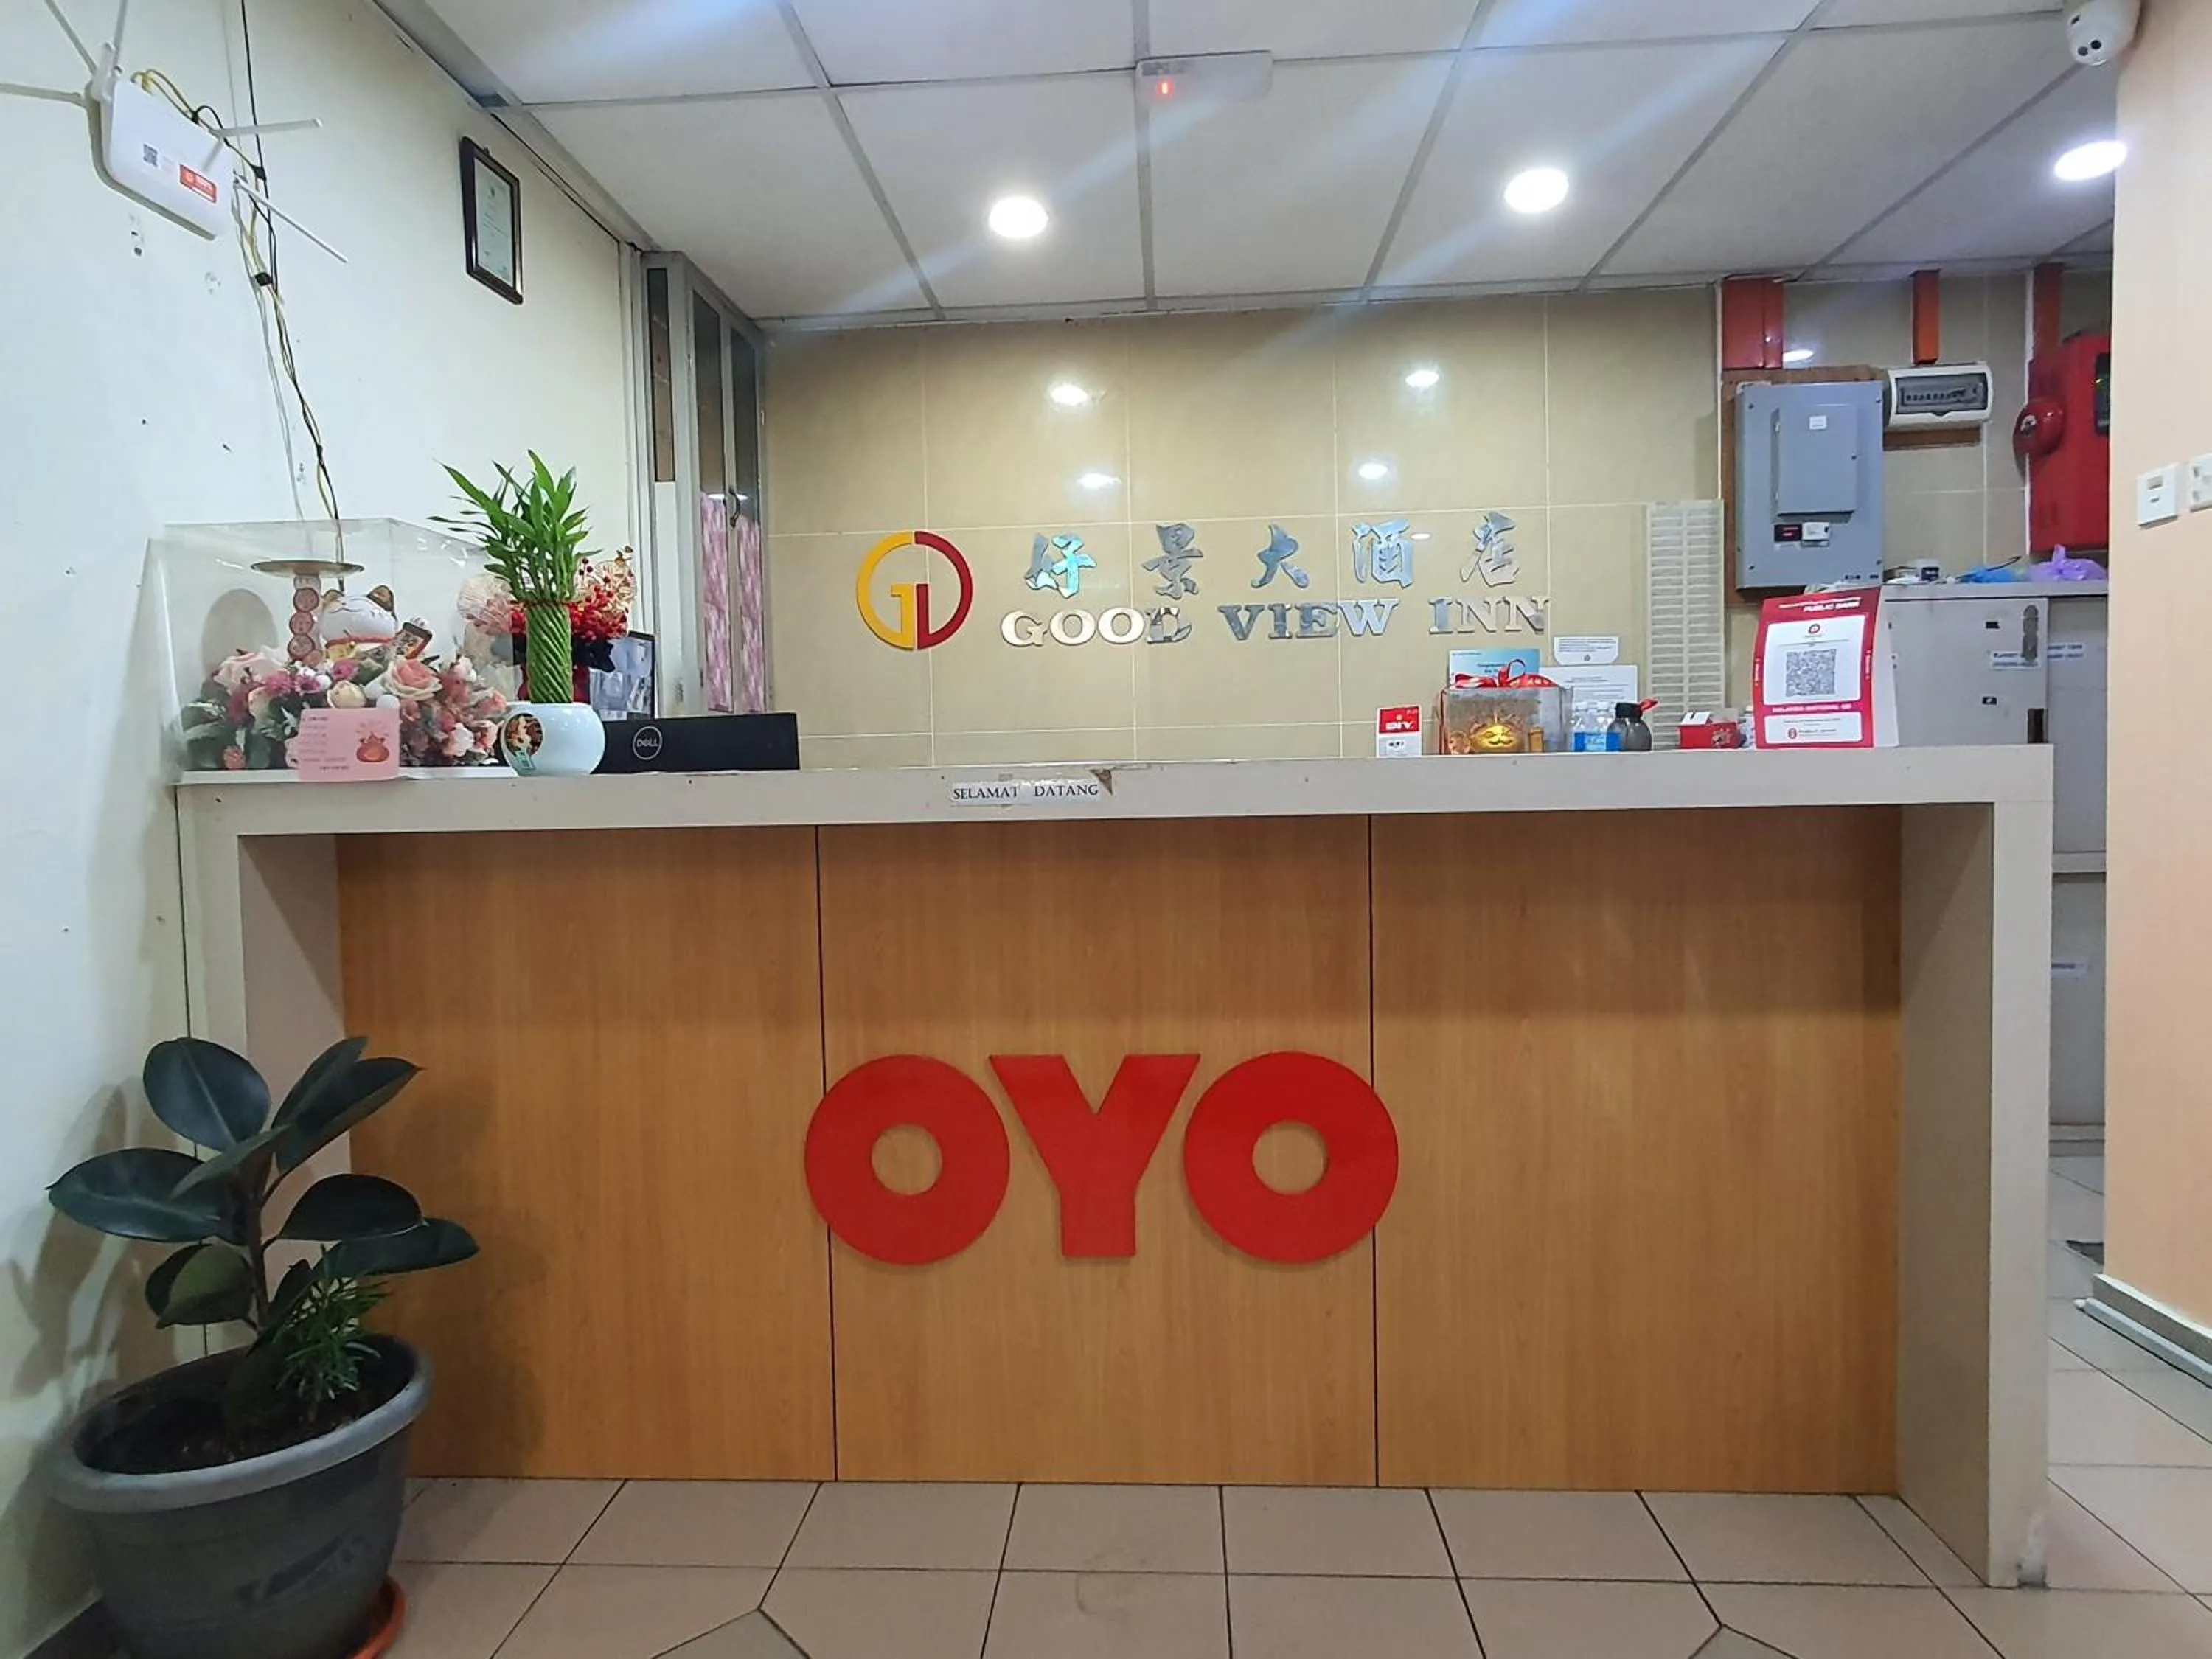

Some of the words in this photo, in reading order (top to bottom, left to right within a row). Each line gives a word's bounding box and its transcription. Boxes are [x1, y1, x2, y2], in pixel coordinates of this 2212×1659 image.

[1001, 606, 1193, 647] GOOD
[1217, 598, 1400, 641] VIEW
[1428, 595, 1549, 635] INN
[636, 736, 658, 748] DELL
[953, 786, 1019, 800] SELAMAT
[1034, 784, 1099, 798] DATANG
[804, 1050, 1399, 1265] OYO
